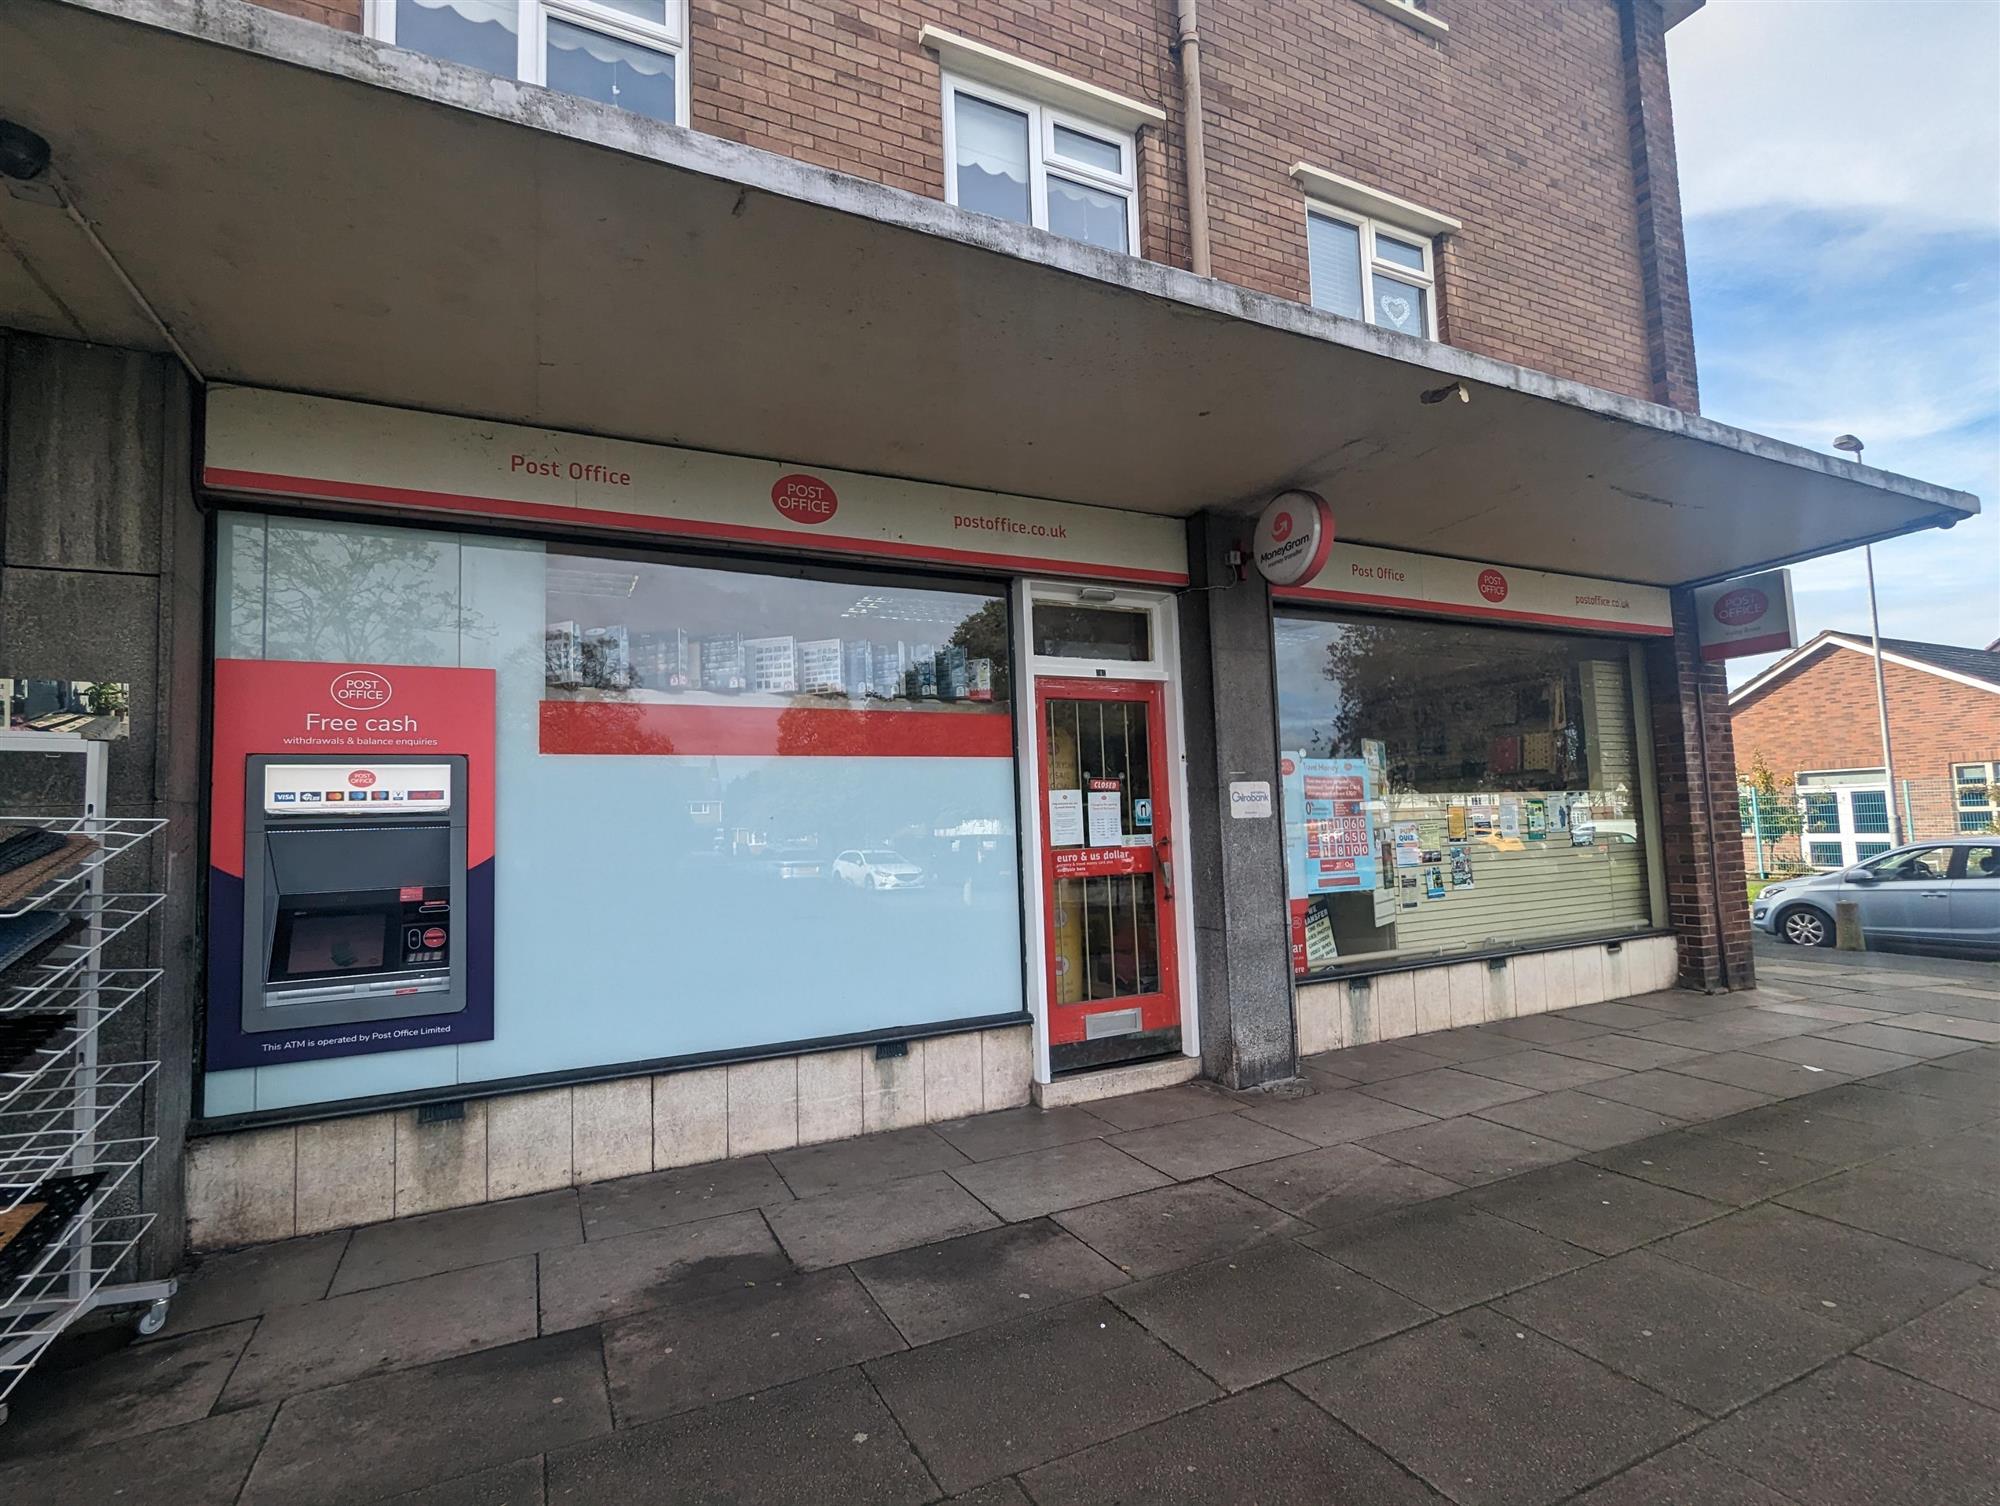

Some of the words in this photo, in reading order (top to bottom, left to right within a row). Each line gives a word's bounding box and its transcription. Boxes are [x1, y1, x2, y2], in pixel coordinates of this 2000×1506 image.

[511, 454, 560, 477] Post
[569, 462, 631, 486] Office
[787, 483, 825, 500] POST
[778, 496, 831, 514] OFFICE
[953, 515, 1067, 539] postoffice.co.uk
[1260, 534, 1310, 564] MoneyGram
[1351, 564, 1374, 578] Post
[1377, 567, 1405, 582] Office
[1484, 575, 1502, 586] POST
[1480, 584, 1505, 596] OFFICE
[1575, 595, 1631, 609] postoffice.co.uk
[1726, 593, 1757, 609] POST
[1719, 603, 1763, 619] OFFICE
[346, 679, 379, 690] POST
[338, 689, 384, 700] OFFICE
[306, 713, 358, 732] Free
[365, 715, 417, 732] cash
[283, 736, 345, 746] withdrawals
[346, 737, 355, 746] &
[356, 737, 394, 747] balance
[395, 738, 438, 747] enquiries
[350, 777, 375, 785] OFFICE
[1094, 781, 1117, 790] CLOSED
[277, 793, 295, 801] VISA
[1398, 834, 1414, 842] QUIZ
[1056, 854, 1078, 862] euro
[1081, 851, 1088, 861] &
[1090, 852, 1101, 861] us
[1103, 849, 1129, 860] dollar
[262, 1043, 282, 1052] This
[284, 1039, 305, 1049] ATM
[308, 1038, 315, 1047] is
[317, 1035, 357, 1046] operated
[359, 1033, 370, 1043] by
[372, 1031, 391, 1040] Post
[393, 1028, 419, 1038] Office
[420, 1025, 451, 1036] Limited
